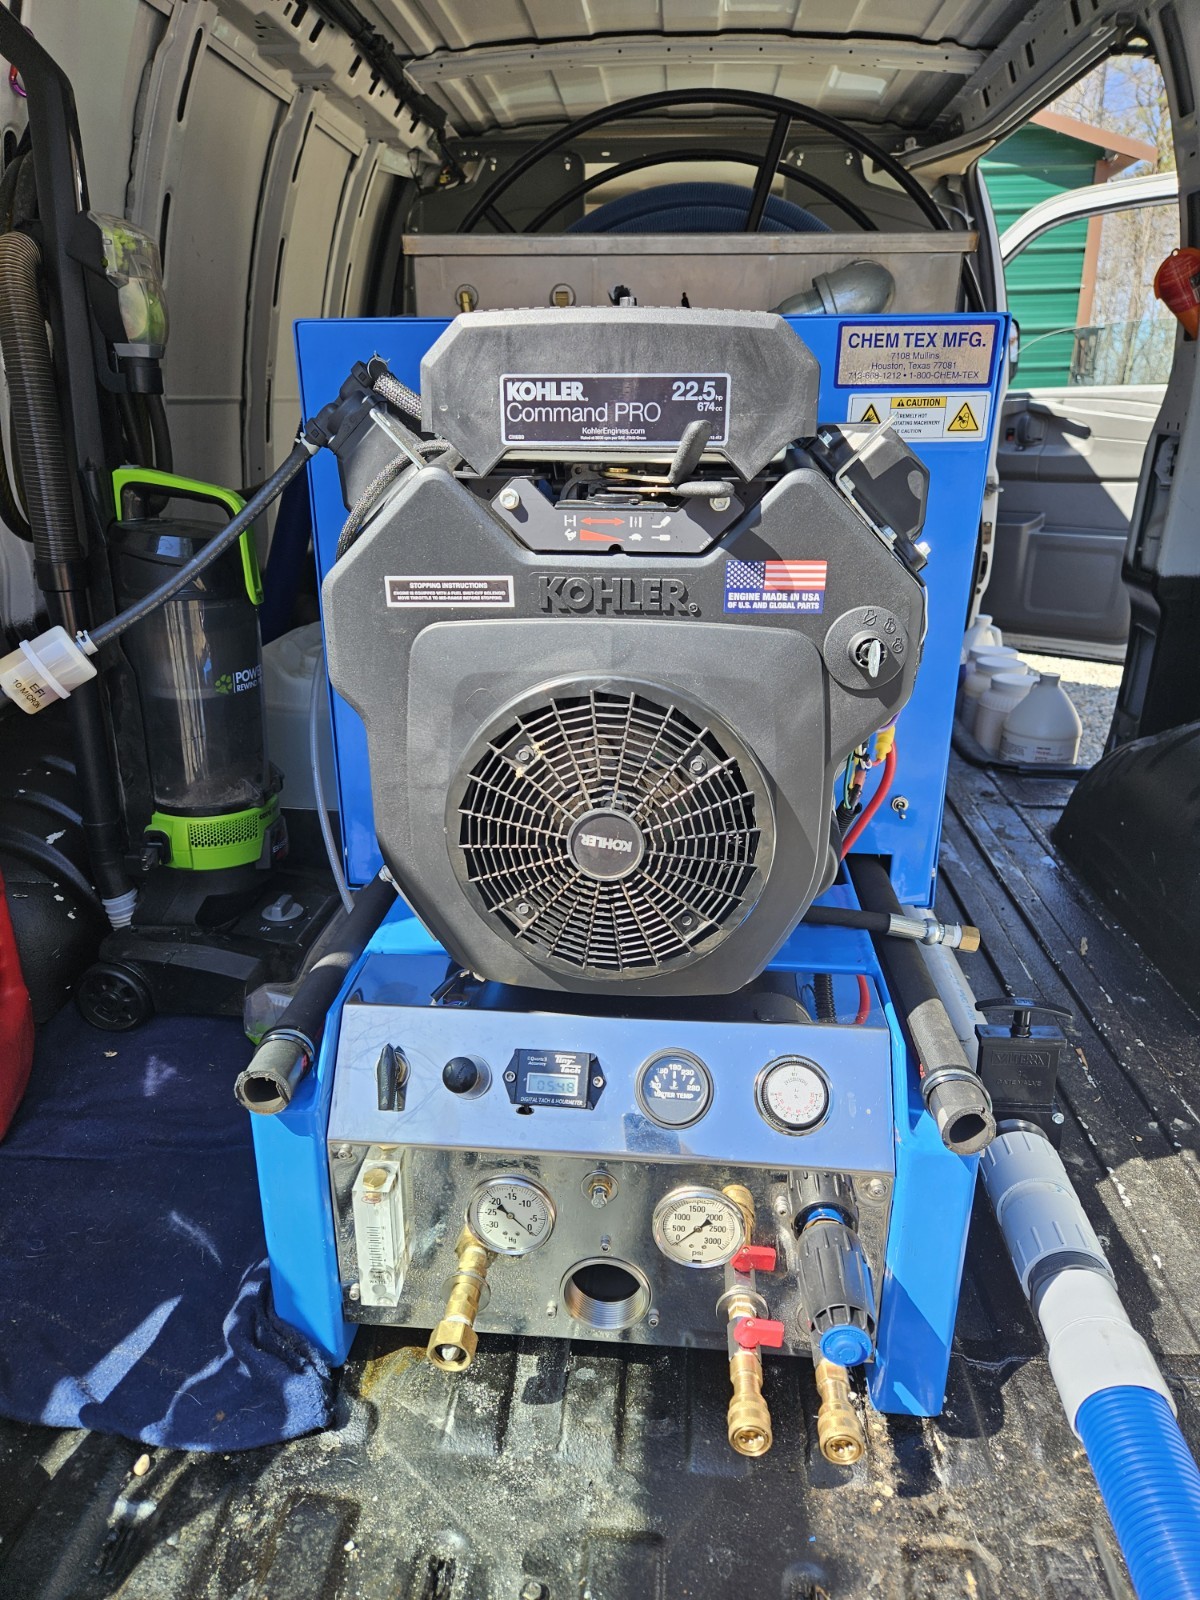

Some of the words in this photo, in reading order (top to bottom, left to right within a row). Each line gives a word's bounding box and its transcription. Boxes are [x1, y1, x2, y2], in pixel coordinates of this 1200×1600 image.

[848, 333, 899, 349] CHEM
[903, 332, 938, 348] TEX
[942, 331, 986, 348] MFG.
[891, 352, 910, 360] 7108
[912, 352, 940, 360] Mullins
[871, 362, 906, 370] Houston,
[908, 362, 931, 370] Texas
[910, 371, 979, 379] 1-800-CHEM-TEX
[506, 381, 586, 402] KOHLER
[906, 398, 941, 407] CAUTION
[506, 402, 608, 422] Command
[614, 402, 662, 422] PRO
[581, 427, 646, 436] KohlerEngines.com
[538, 576, 692, 615] KOHLER
[728, 592, 760, 602] ENGINE
[762, 592, 789, 602] MADE
[791, 593, 800, 602] IN
[802, 593, 821, 602] USA
[796, 602, 820, 610] PARTS
[12, 678, 22, 688] 10
[20, 687, 42, 709] MICRON
[29, 683, 46, 698] EFI
[578, 833, 633, 853] KOHLER
[560, 1064, 582, 1074] Tach
[555, 1098, 583, 1106] HOURMETER
[504, 1192, 517, 1200] -15
[489, 1198, 501, 1206] -20
[518, 1200, 532, 1208] -10
[485, 1208, 497, 1216] -25
